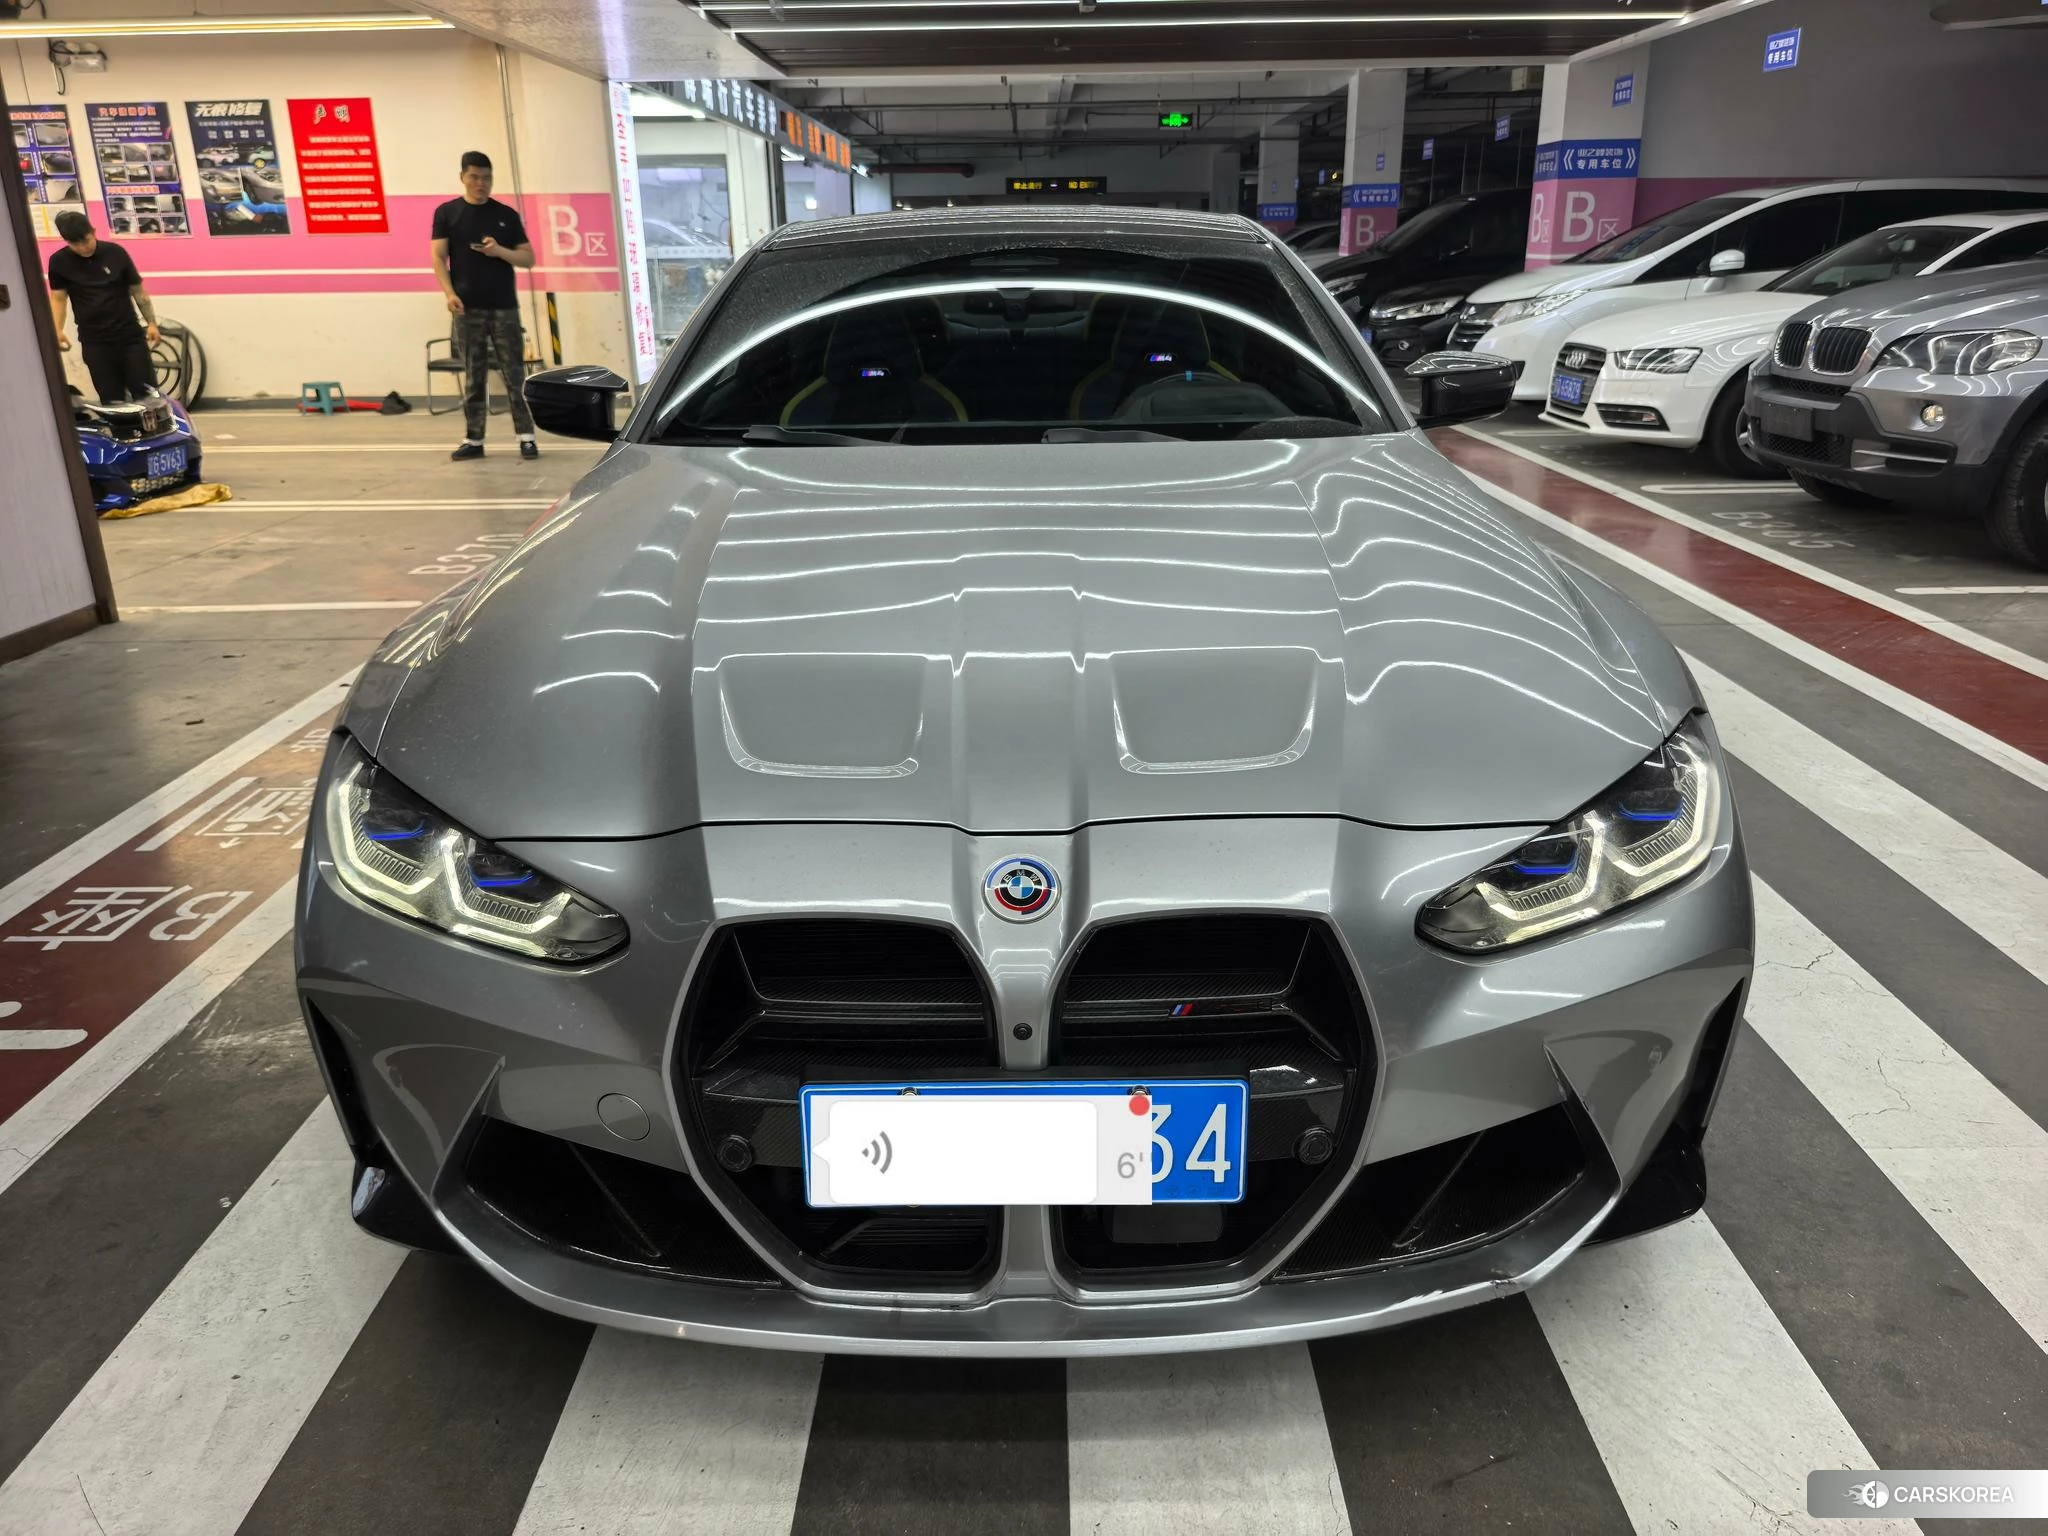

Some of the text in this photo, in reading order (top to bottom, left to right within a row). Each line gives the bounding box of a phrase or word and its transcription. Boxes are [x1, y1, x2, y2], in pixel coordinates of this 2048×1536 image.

[1577, 158, 1623, 170] 专用车位
[1003, 869, 1040, 883] BMW
[3, 884, 254, 951] B座
